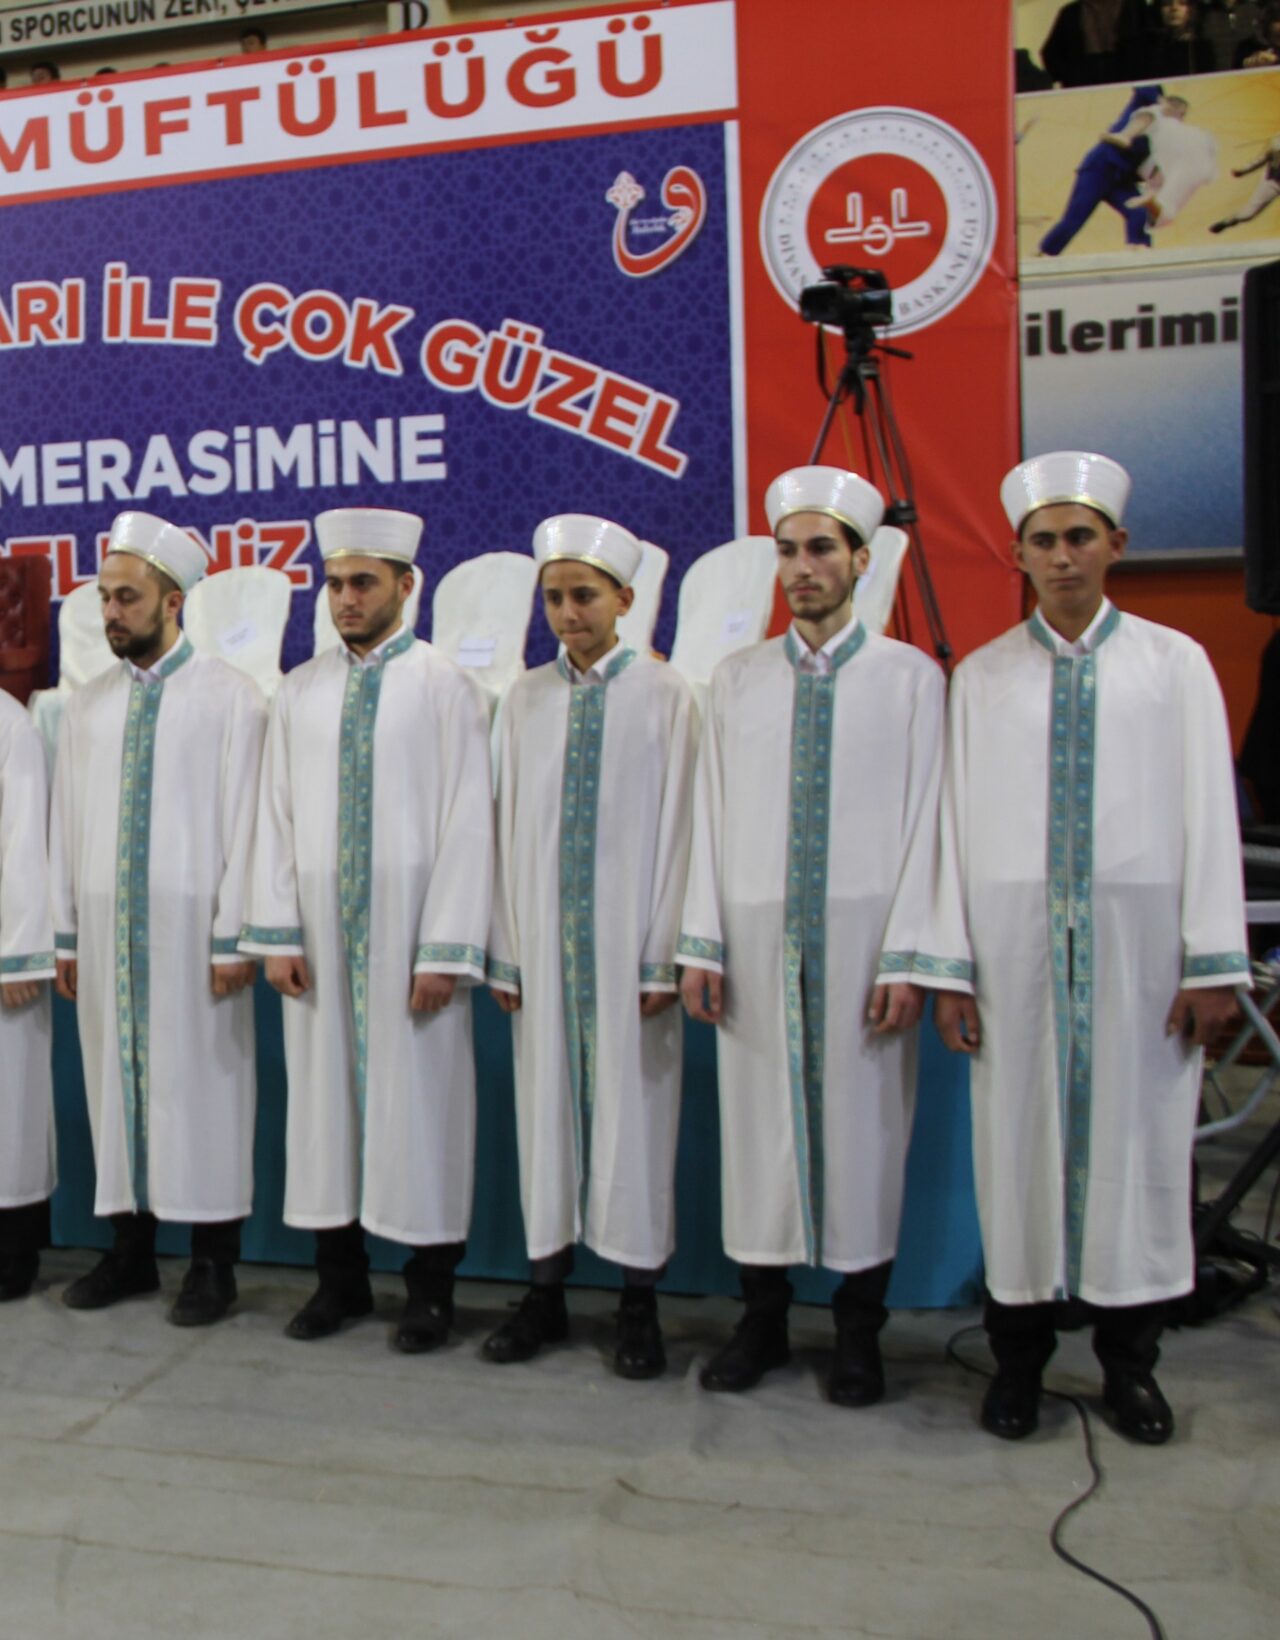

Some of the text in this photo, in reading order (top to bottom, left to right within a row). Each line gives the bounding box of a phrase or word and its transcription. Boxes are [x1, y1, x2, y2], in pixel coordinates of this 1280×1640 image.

[11, 0, 156, 42] SPORCUNUN
[103, 262, 221, 346] İLE
[234, 283, 414, 377] ÇOK
[422, 318, 690, 479] GÜZEL
